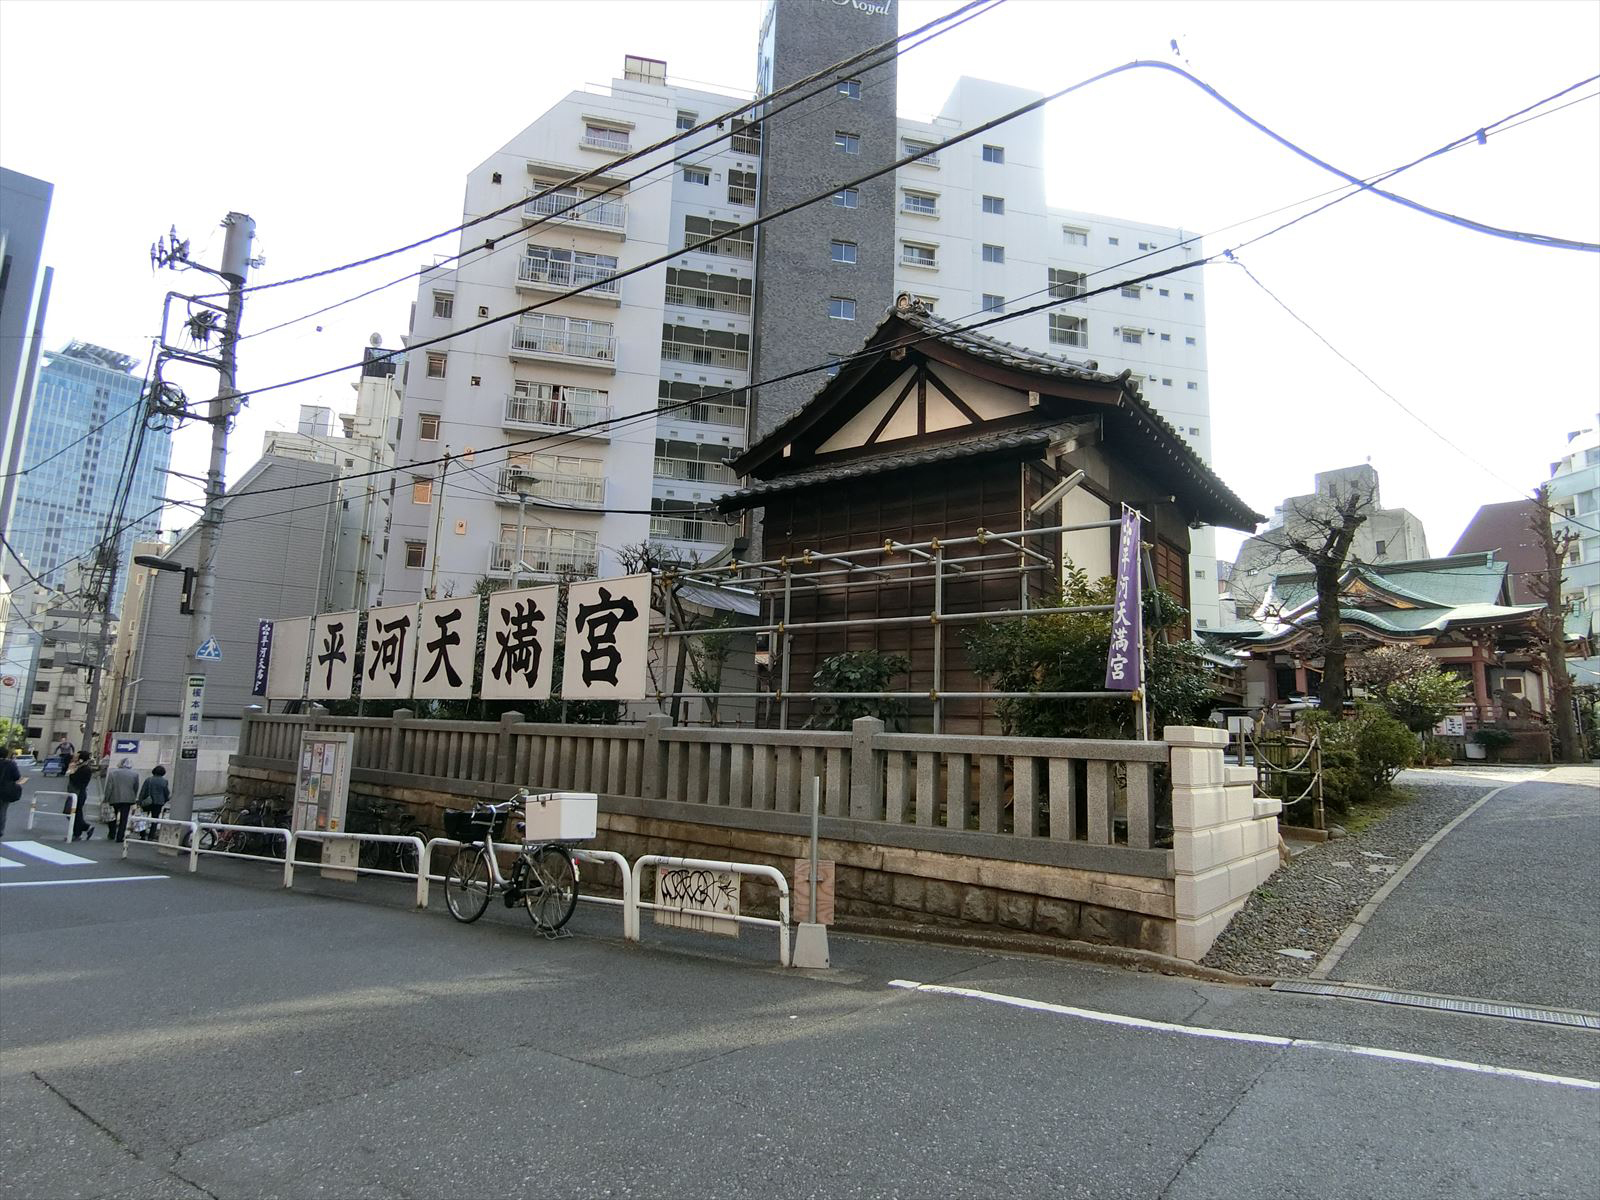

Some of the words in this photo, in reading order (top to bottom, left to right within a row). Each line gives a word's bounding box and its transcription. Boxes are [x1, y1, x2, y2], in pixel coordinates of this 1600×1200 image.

[318, 587, 638, 691] 平河天満宮
